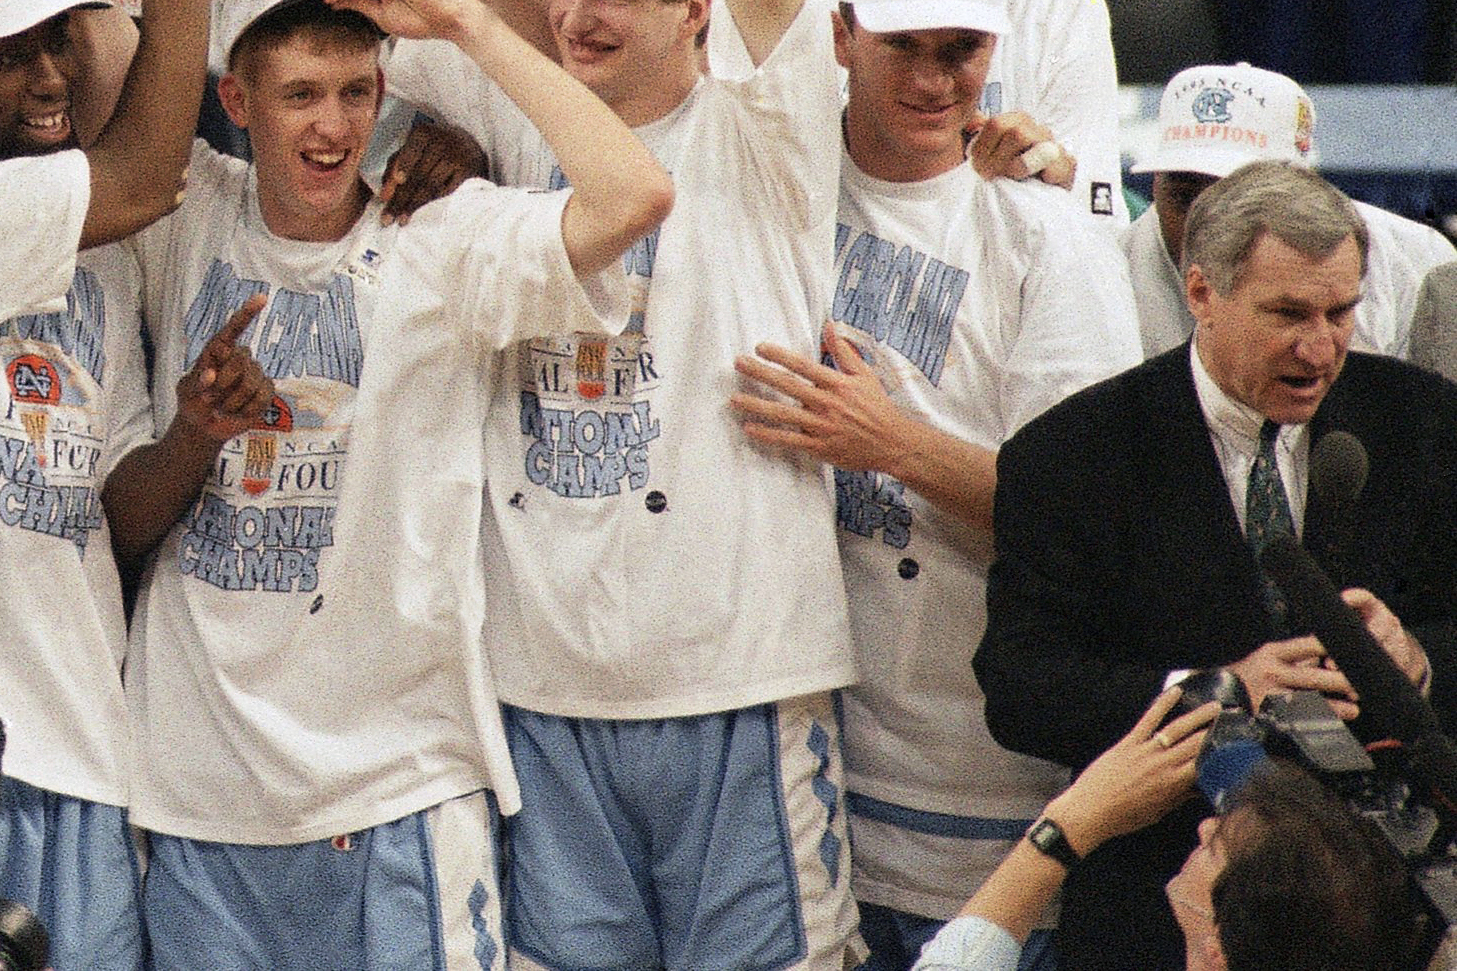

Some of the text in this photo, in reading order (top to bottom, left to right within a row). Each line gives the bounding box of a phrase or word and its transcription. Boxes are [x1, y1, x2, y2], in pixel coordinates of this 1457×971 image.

[1162, 125, 1269, 149] CHAMPIONS
[276, 459, 340, 492] FOU
[178, 530, 321, 593] CHAMPS
